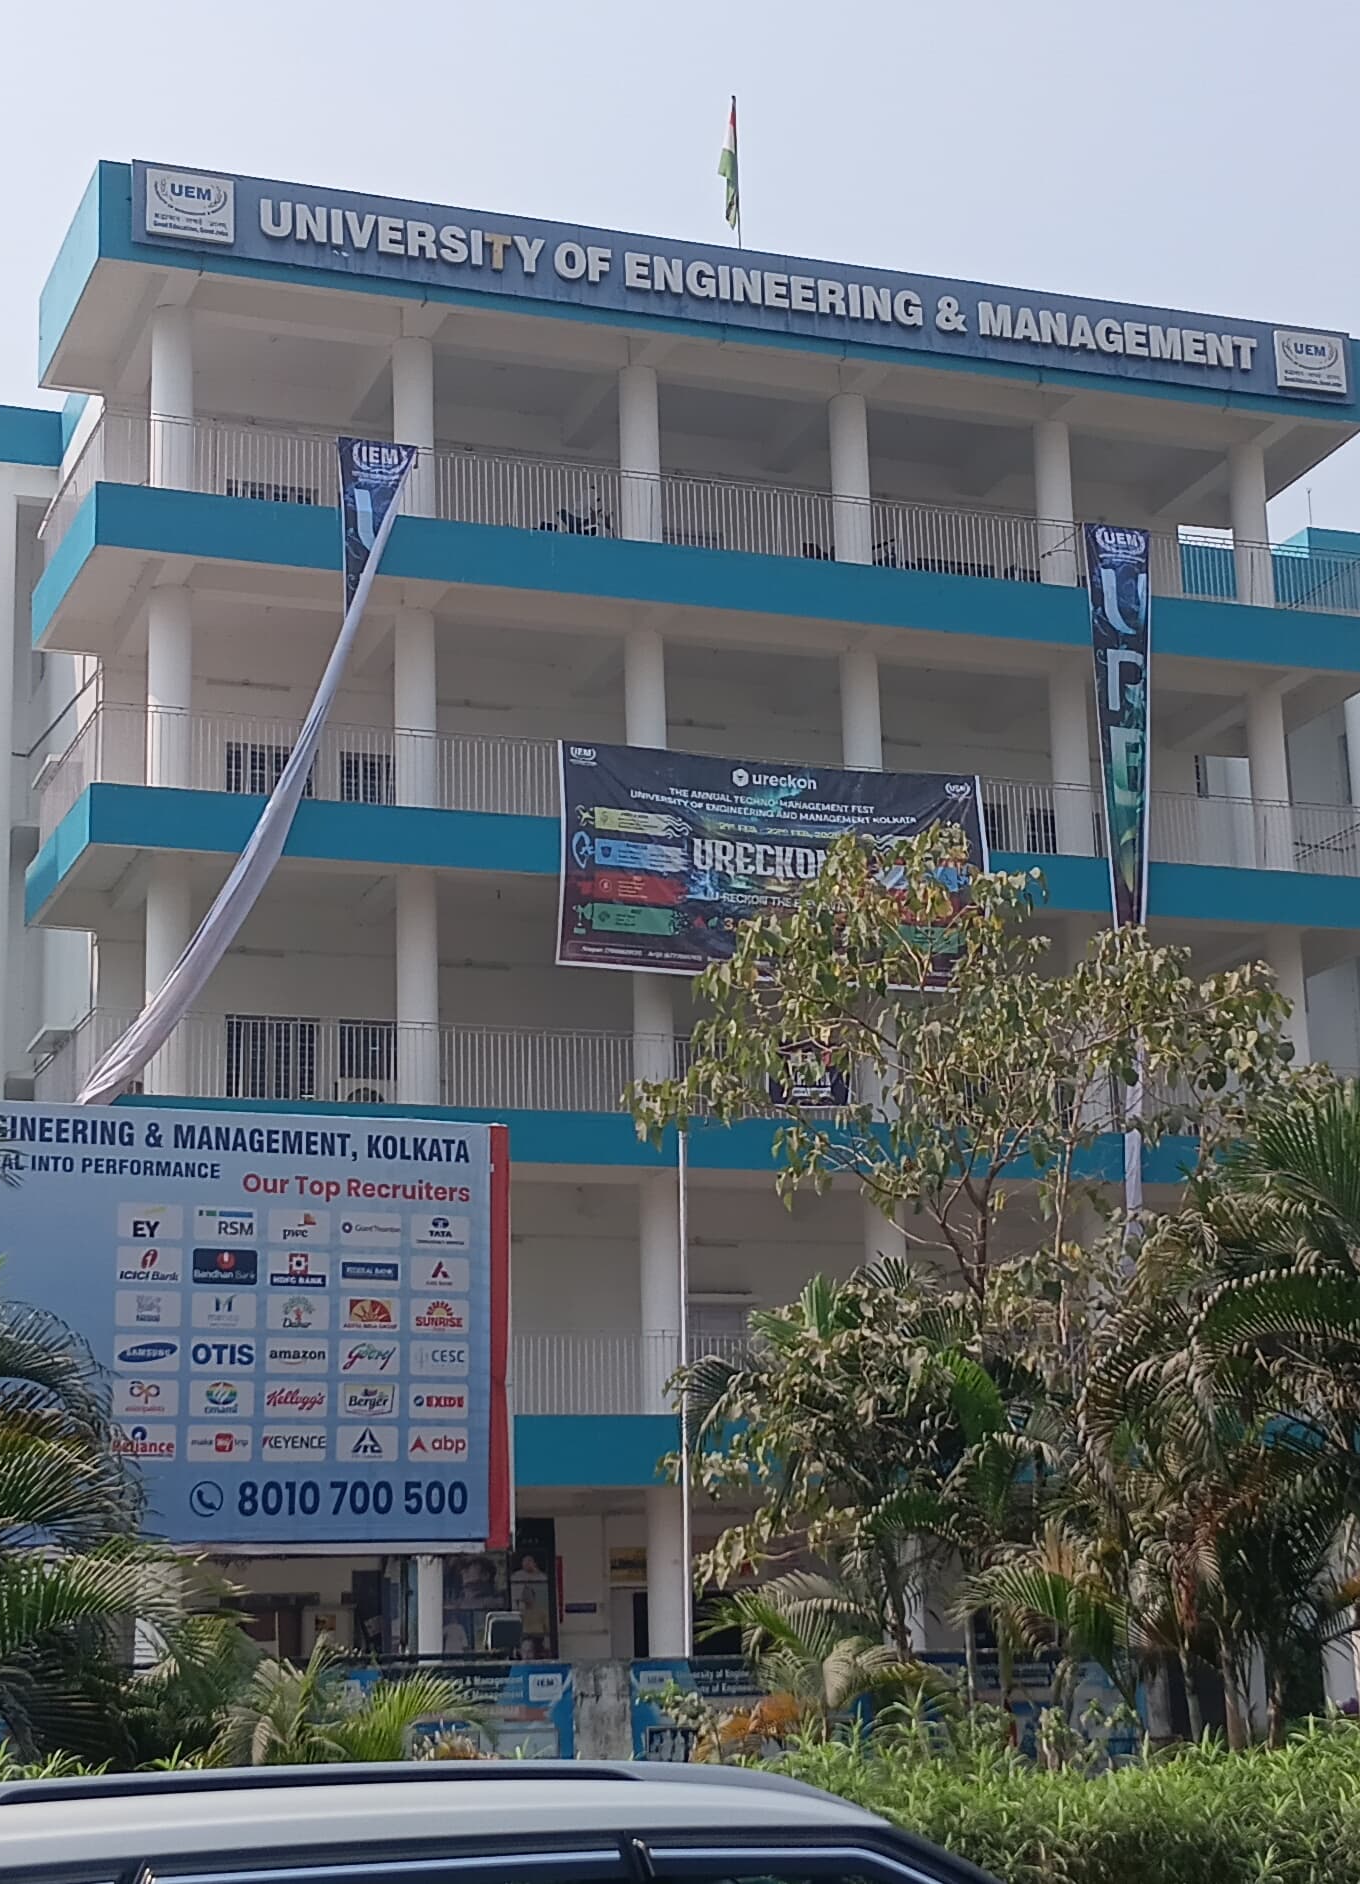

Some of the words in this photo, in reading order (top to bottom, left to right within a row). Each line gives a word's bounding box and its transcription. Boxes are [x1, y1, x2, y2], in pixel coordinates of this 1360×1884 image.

[170, 183, 212, 201] UEM
[259, 197, 545, 273] UNIVERSITY
[554, 242, 612, 283] OF
[625, 252, 924, 327] ENGINEERING
[934, 296, 969, 333] &
[978, 301, 1258, 371] MANAGEMENT
[1293, 342, 1327, 358] UEM
[361, 446, 400, 465] IEM
[1103, 531, 1140, 547] UEM
[751, 774, 818, 791] ureckon
[630, 788, 691, 808] UNIVERSITY
[690, 801, 705, 810] OF
[705, 803, 775, 818] ENGINEERING
[776, 810, 798, 821] AND
[799, 812, 871, 825] MANAGEMENT
[872, 817, 918, 825] KOLKATA
[669, 787, 690, 799] THE
[691, 790, 733, 804] ANNUAL
[851, 805, 875, 815] FEST
[144, 1122, 164, 1149] &
[173, 1124, 358, 1162] MANAGEMENT,
[366, 1134, 471, 1164] KOLKATA
[31, 1155, 74, 1174] INTO
[81, 1157, 221, 1179] PERFORMANCE
[242, 1173, 290, 1195] Our
[294, 1175, 341, 1202] Top
[346, 1178, 471, 1202] Recruiters
[132, 1220, 160, 1238] EY
[217, 1221, 254, 1236] RSM
[282, 1229, 309, 1240] pwc
[428, 1230, 452, 1238] TATA
[119, 1270, 150, 1281] ICICI
[151, 1271, 179, 1282] Bank
[193, 1269, 234, 1279] Bandhan
[272, 1276, 297, 1285] HDFC
[298, 1276, 323, 1285] BANK
[415, 1316, 464, 1328] SUNRISE
[126, 1346, 172, 1358] SAMSUNG
[191, 1343, 254, 1366] OTIS
[269, 1349, 326, 1361] amazon
[431, 1349, 465, 1363] CESC
[266, 1387, 326, 1411] Kellogg's
[348, 1394, 389, 1411] Berger
[425, 1395, 465, 1408] EXIDE
[262, 1435, 327, 1449] KEYENCE
[431, 1434, 466, 1454] abp
[237, 1480, 320, 1517] 8010
[329, 1480, 394, 1516] 700
[404, 1480, 468, 1515] 500
